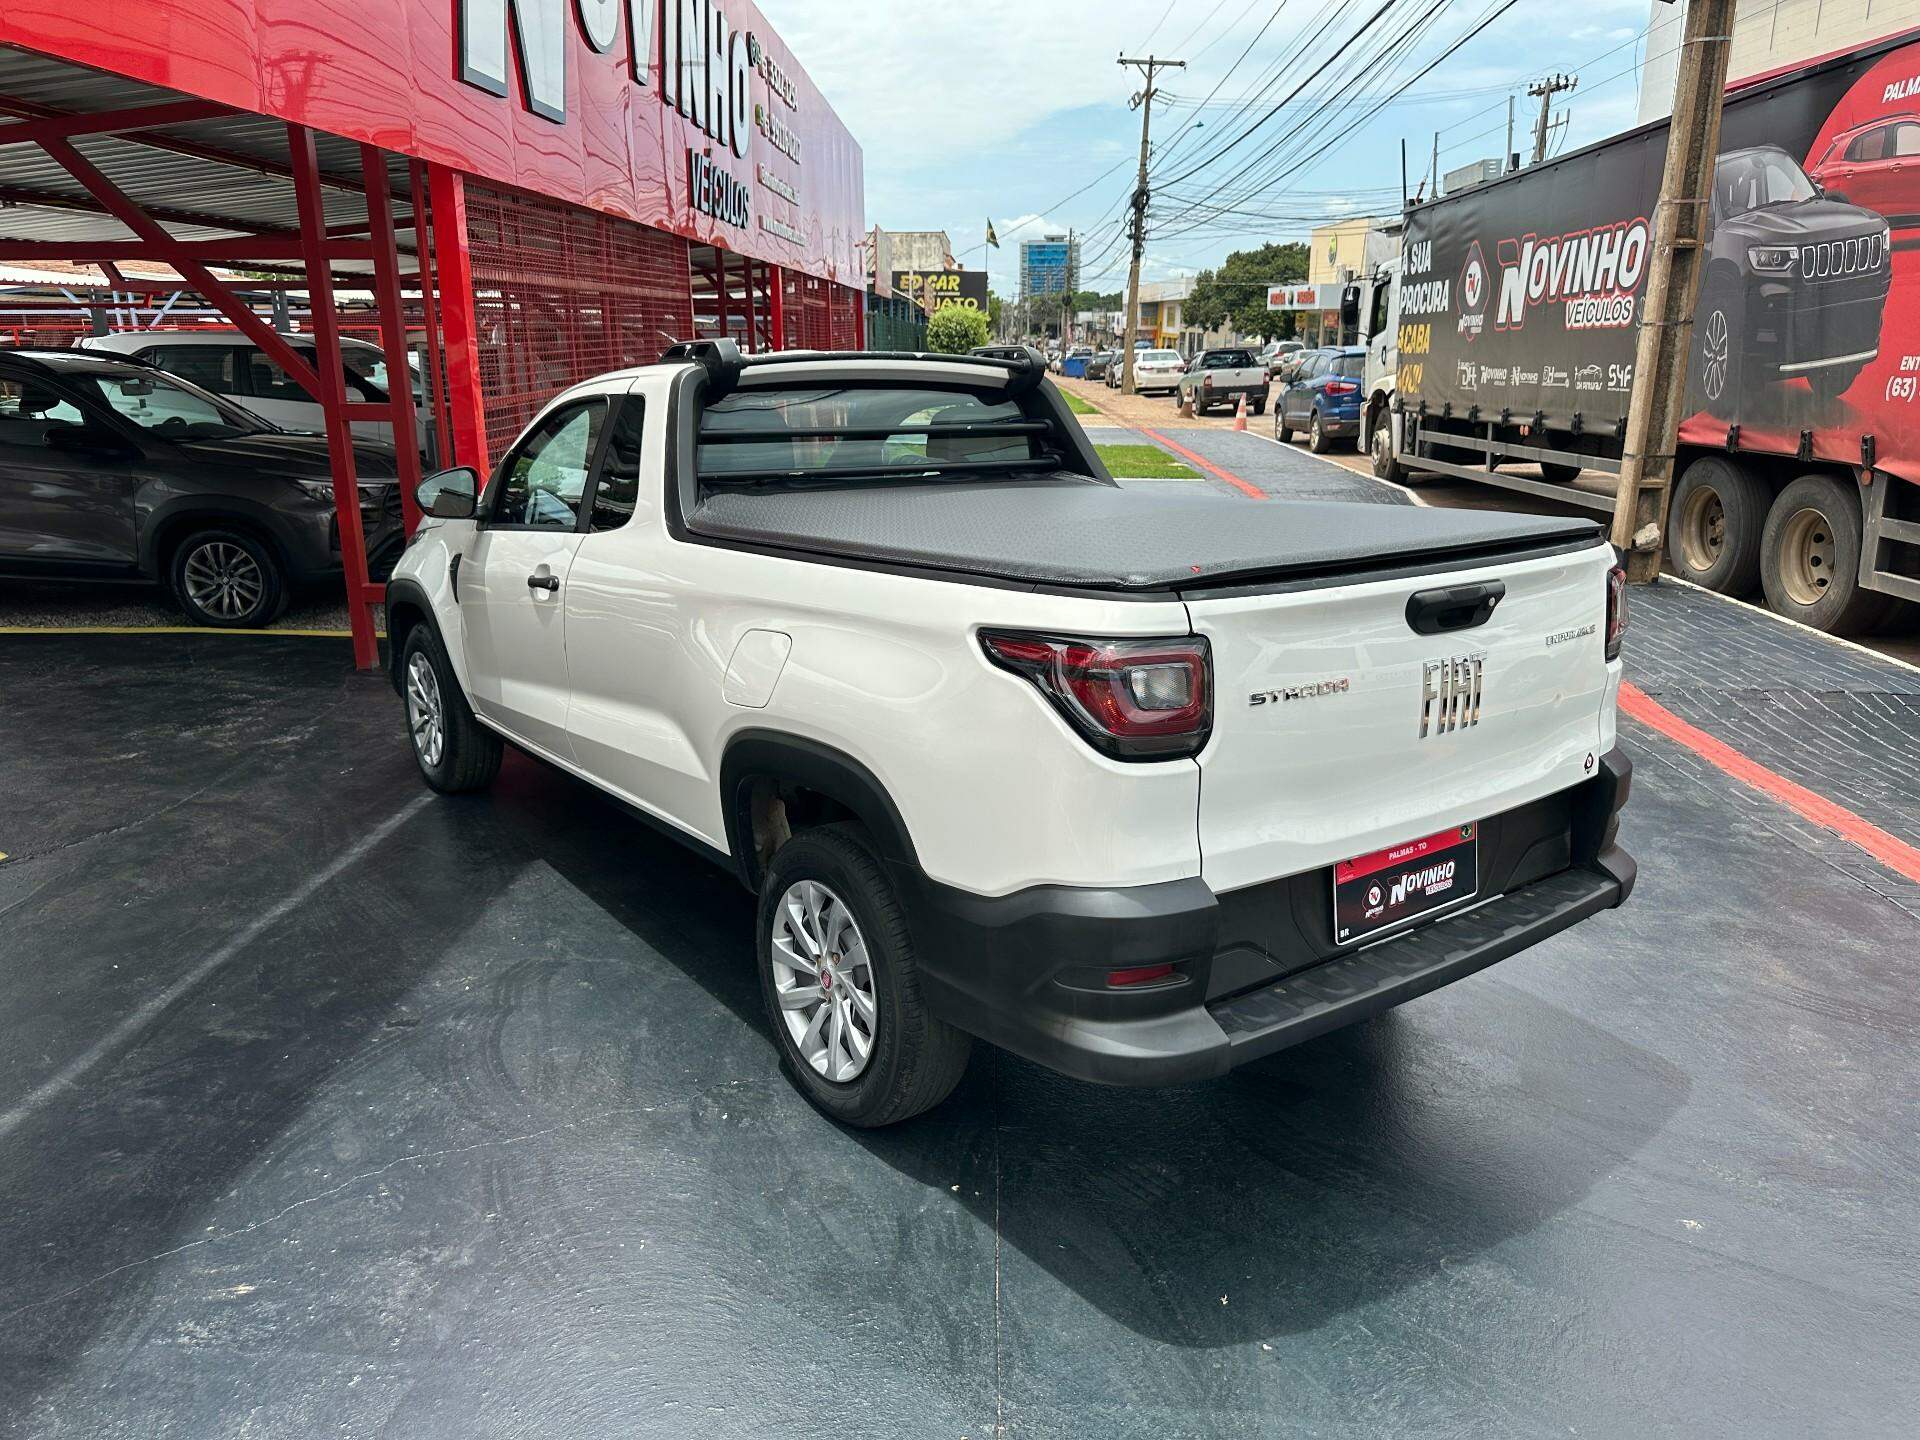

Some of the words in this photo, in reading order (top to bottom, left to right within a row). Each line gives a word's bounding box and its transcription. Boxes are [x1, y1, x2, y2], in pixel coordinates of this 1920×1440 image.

[1882, 76, 1920, 103] PALM
[687, 148, 748, 229] VEÍCULOS
[1402, 245, 1409, 275] A
[1410, 240, 1432, 275] SUA
[1496, 224, 1647, 324] NOVINHO
[1400, 280, 1450, 315] PROCURA
[1566, 295, 1632, 327] VEÍCULOS
[1886, 375, 1917, 402] (63)
[1249, 677, 1350, 706] STRADA
[1418, 649, 1488, 739] FIAT
[1389, 846, 1414, 860] PALMAS
[1418, 842, 1427, 852] TO
[1390, 861, 1455, 905] NOVINHO
[1340, 928, 1349, 937] BR
